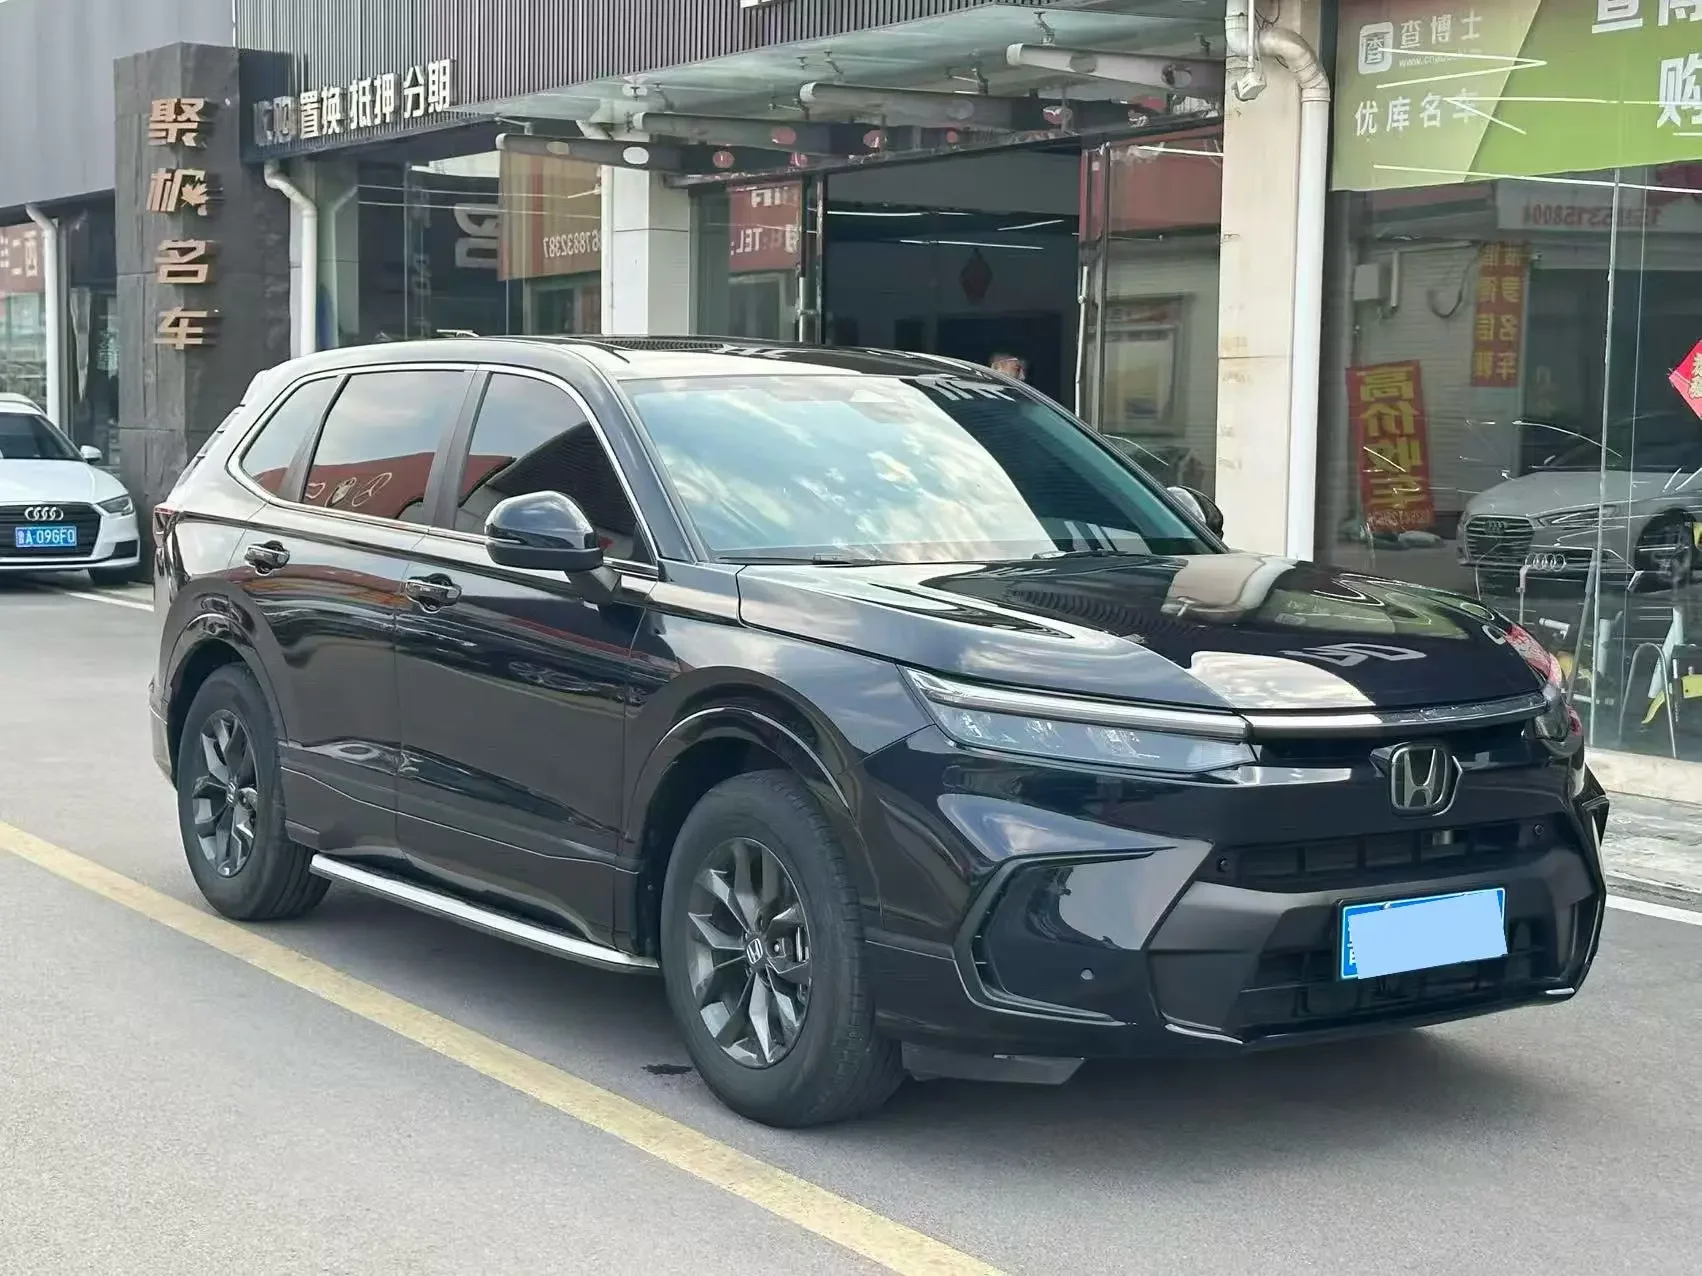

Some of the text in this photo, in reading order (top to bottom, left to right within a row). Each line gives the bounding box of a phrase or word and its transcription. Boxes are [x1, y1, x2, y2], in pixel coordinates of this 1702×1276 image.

[1400, 9, 1483, 48] 查博士
[300, 87, 342, 139] 置换
[350, 73, 396, 129] 抵押
[403, 59, 451, 118] 分期
[1355, 88, 1479, 136] 优库名车
